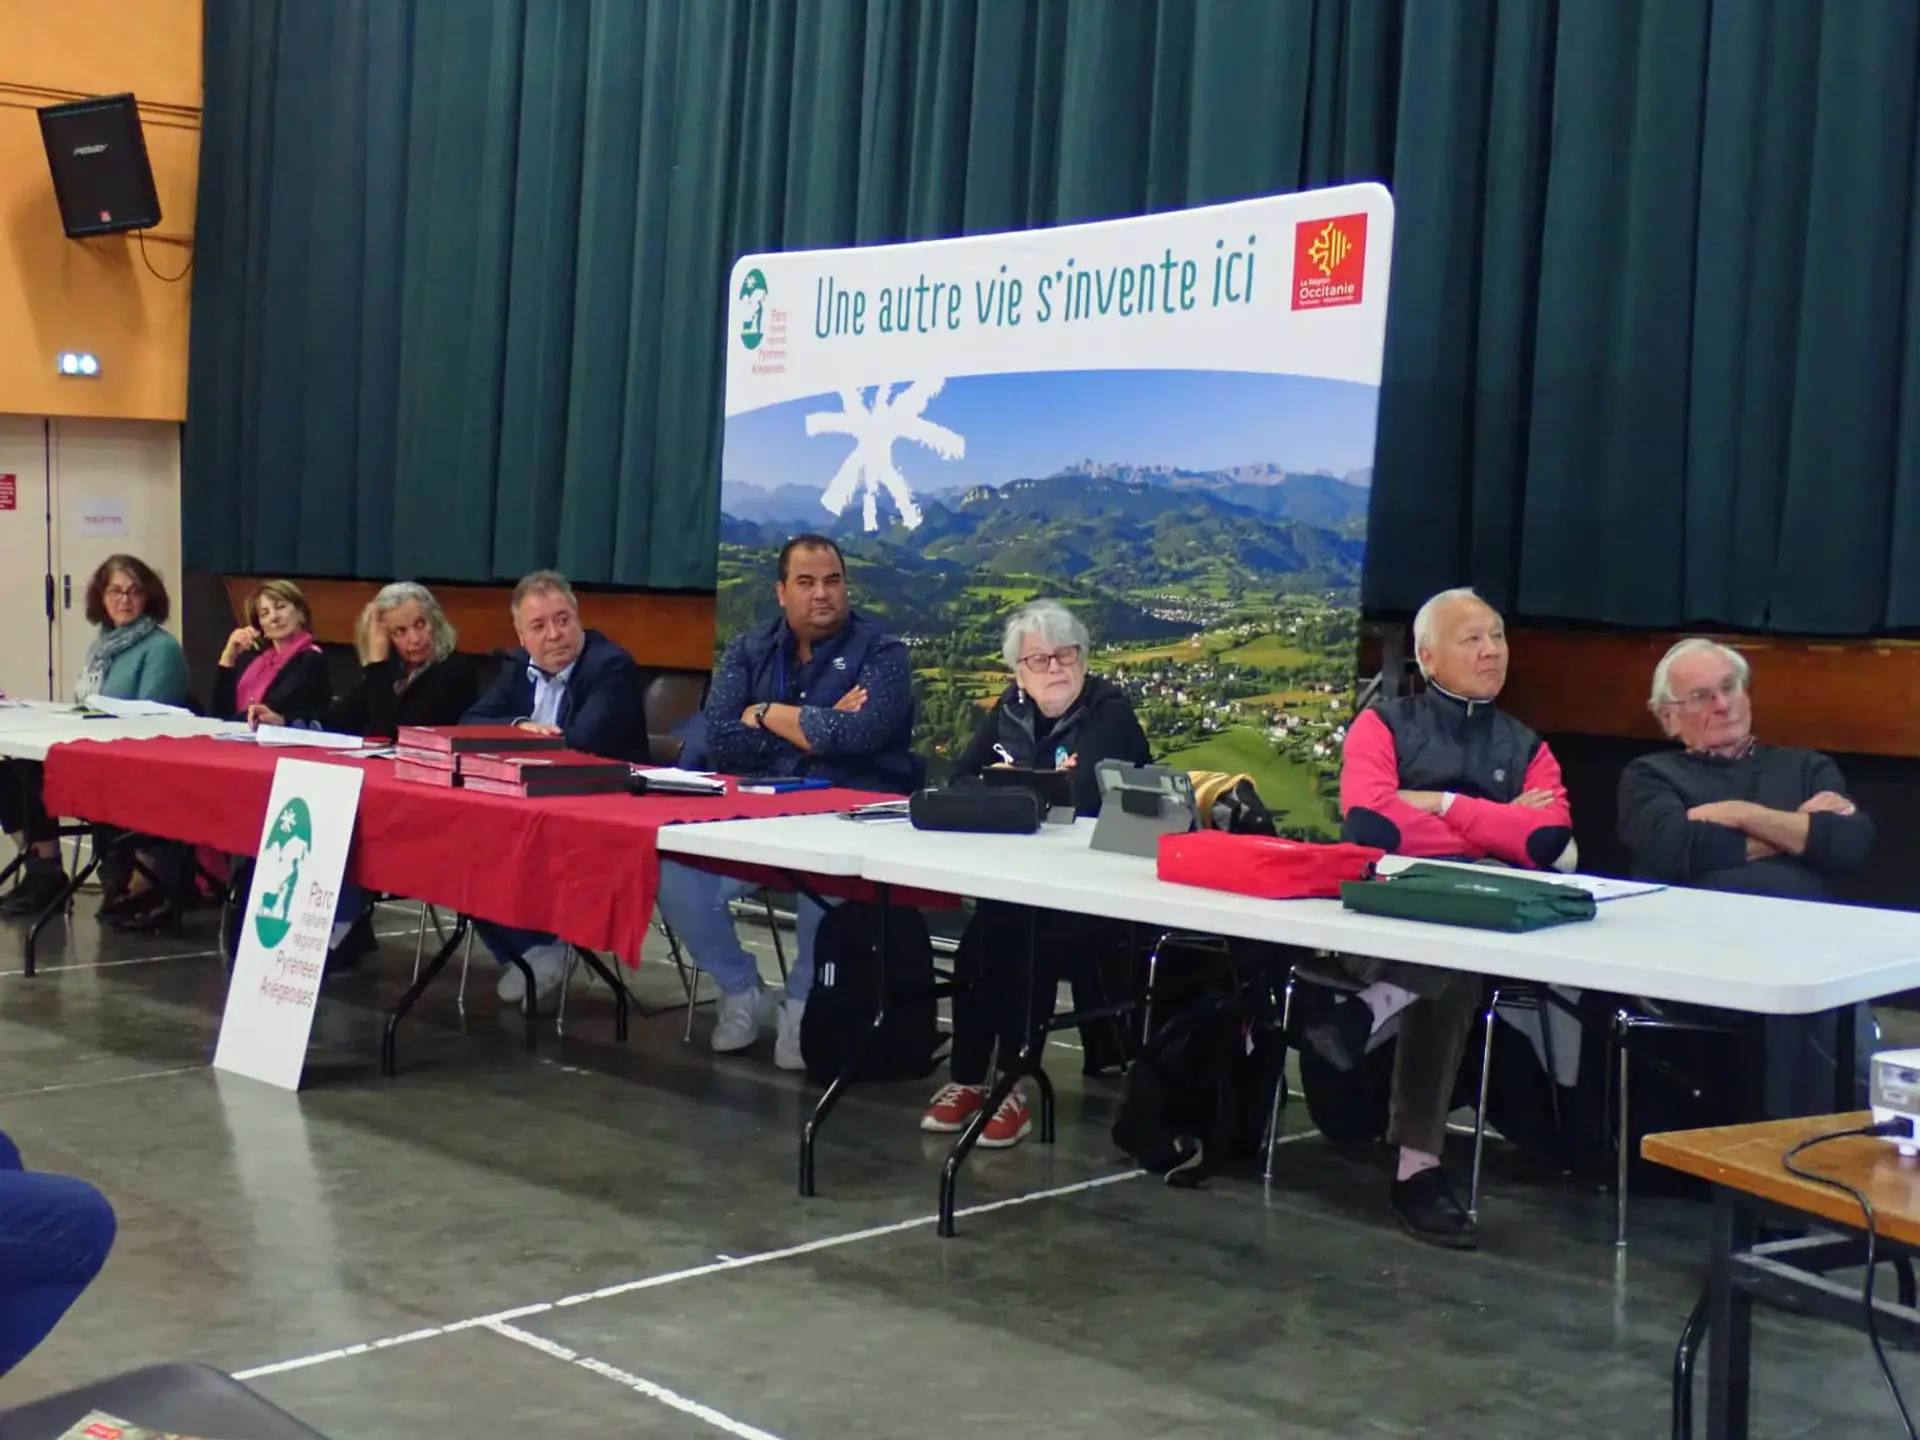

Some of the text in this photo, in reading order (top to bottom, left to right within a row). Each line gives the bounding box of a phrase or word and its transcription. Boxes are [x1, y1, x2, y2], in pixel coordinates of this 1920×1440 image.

[815, 234, 1257, 339] Une autre vie s'invente ici
[1300, 281, 1355, 299] Occitanie
[309, 880, 334, 909] Parc
